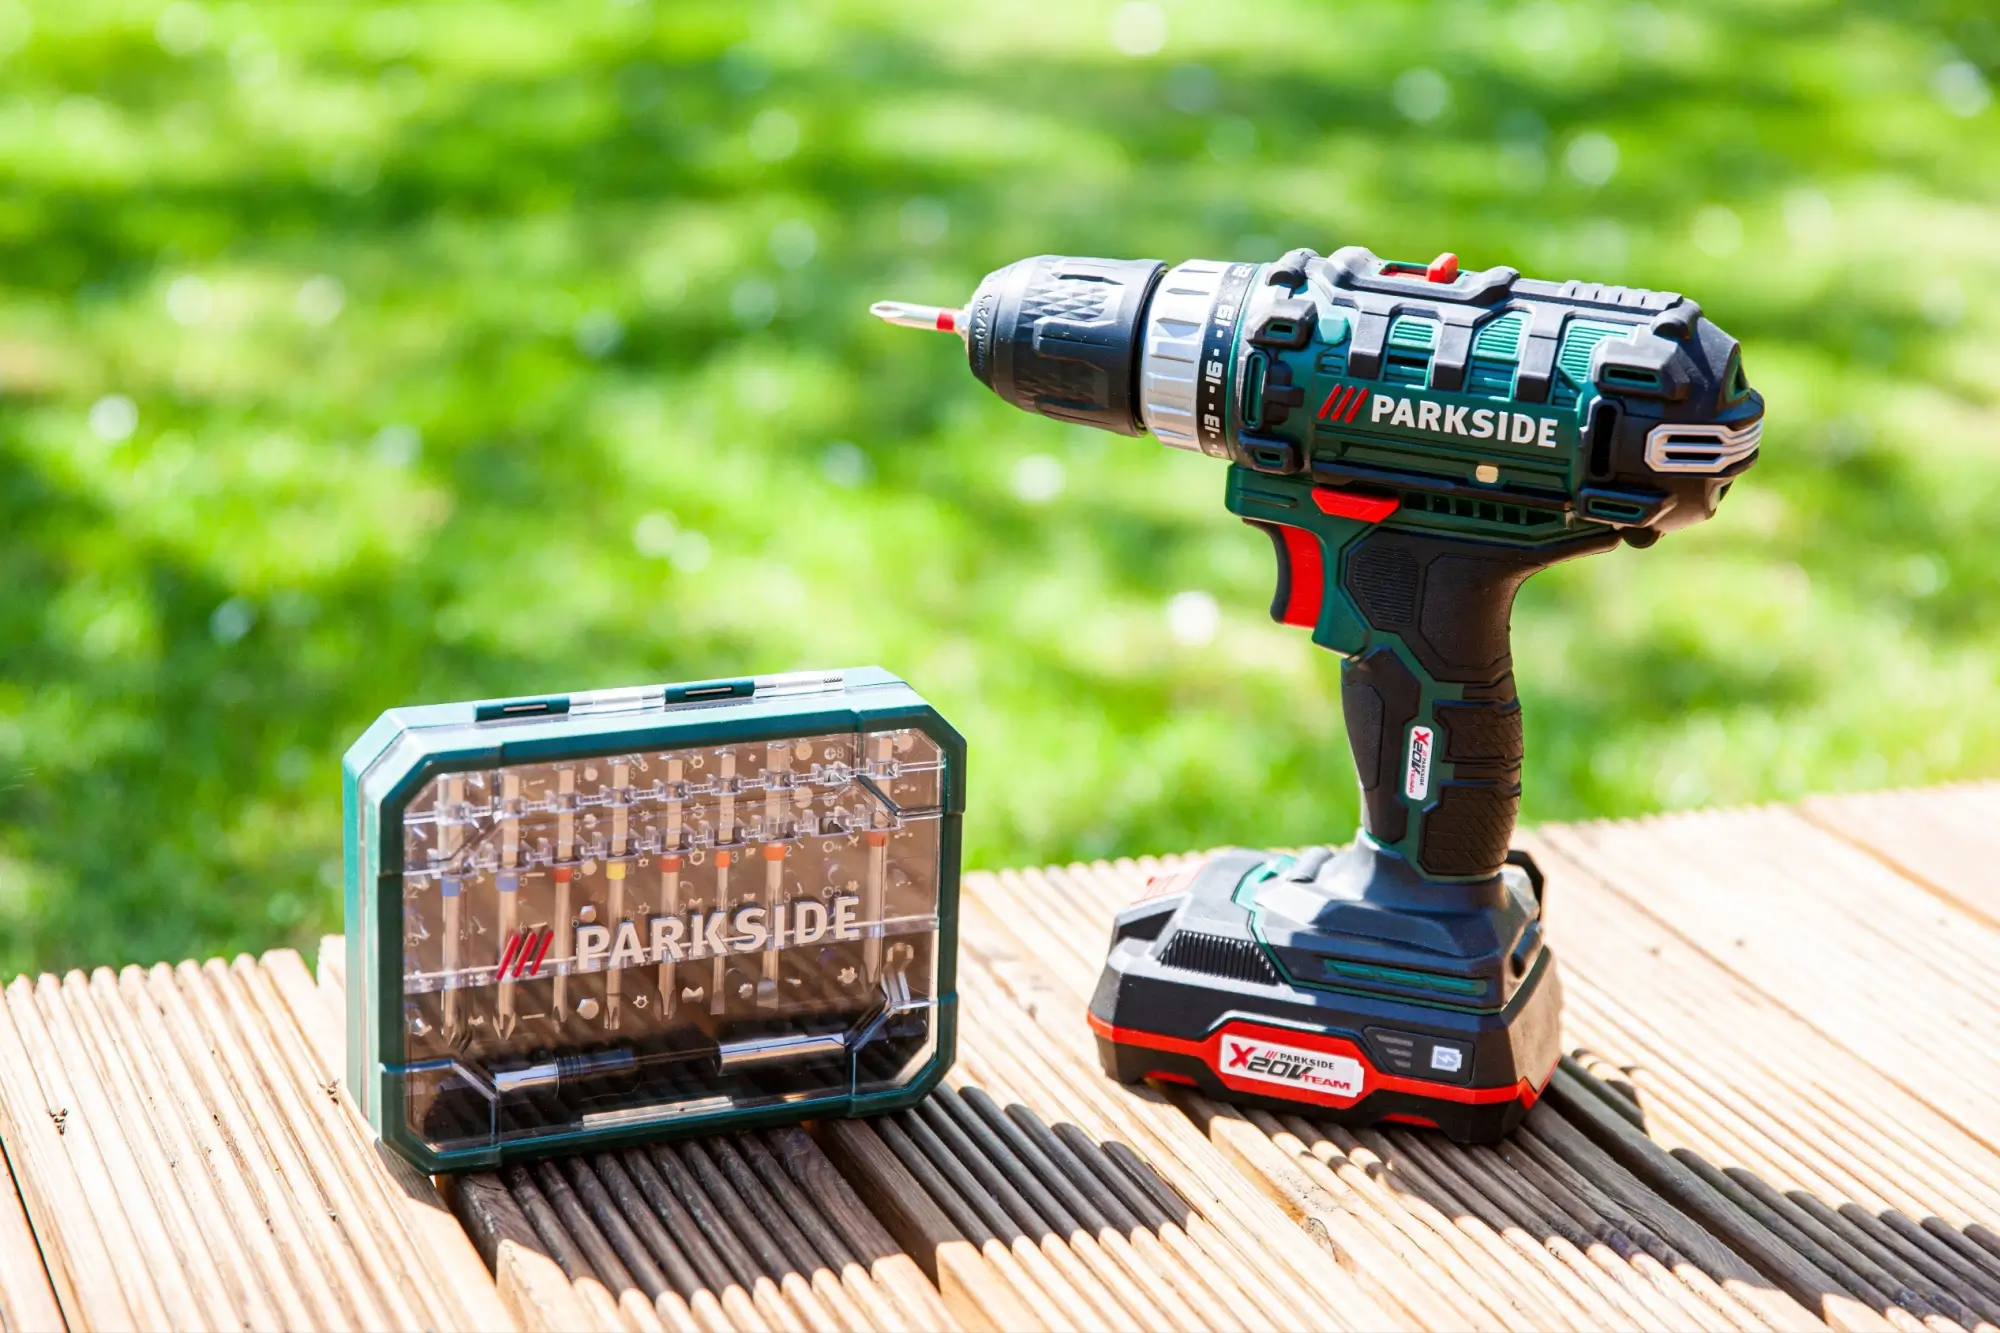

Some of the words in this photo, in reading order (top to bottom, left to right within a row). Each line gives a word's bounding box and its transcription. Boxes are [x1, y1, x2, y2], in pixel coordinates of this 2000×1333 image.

[1215, 304, 1235, 327] 19
[1205, 359, 1223, 385] 16
[1204, 413, 1221, 434] 13
[1371, 393, 1559, 449] PARKSIDE
[1419, 757, 1427, 786] PARKSIDE
[731, 851, 739, 863] 3
[784, 845, 793, 857] 2
[576, 895, 860, 970] PARKSIDE
[1279, 1052, 1336, 1070] PARKSIDE
[1300, 1073, 1351, 1091] TEAM
